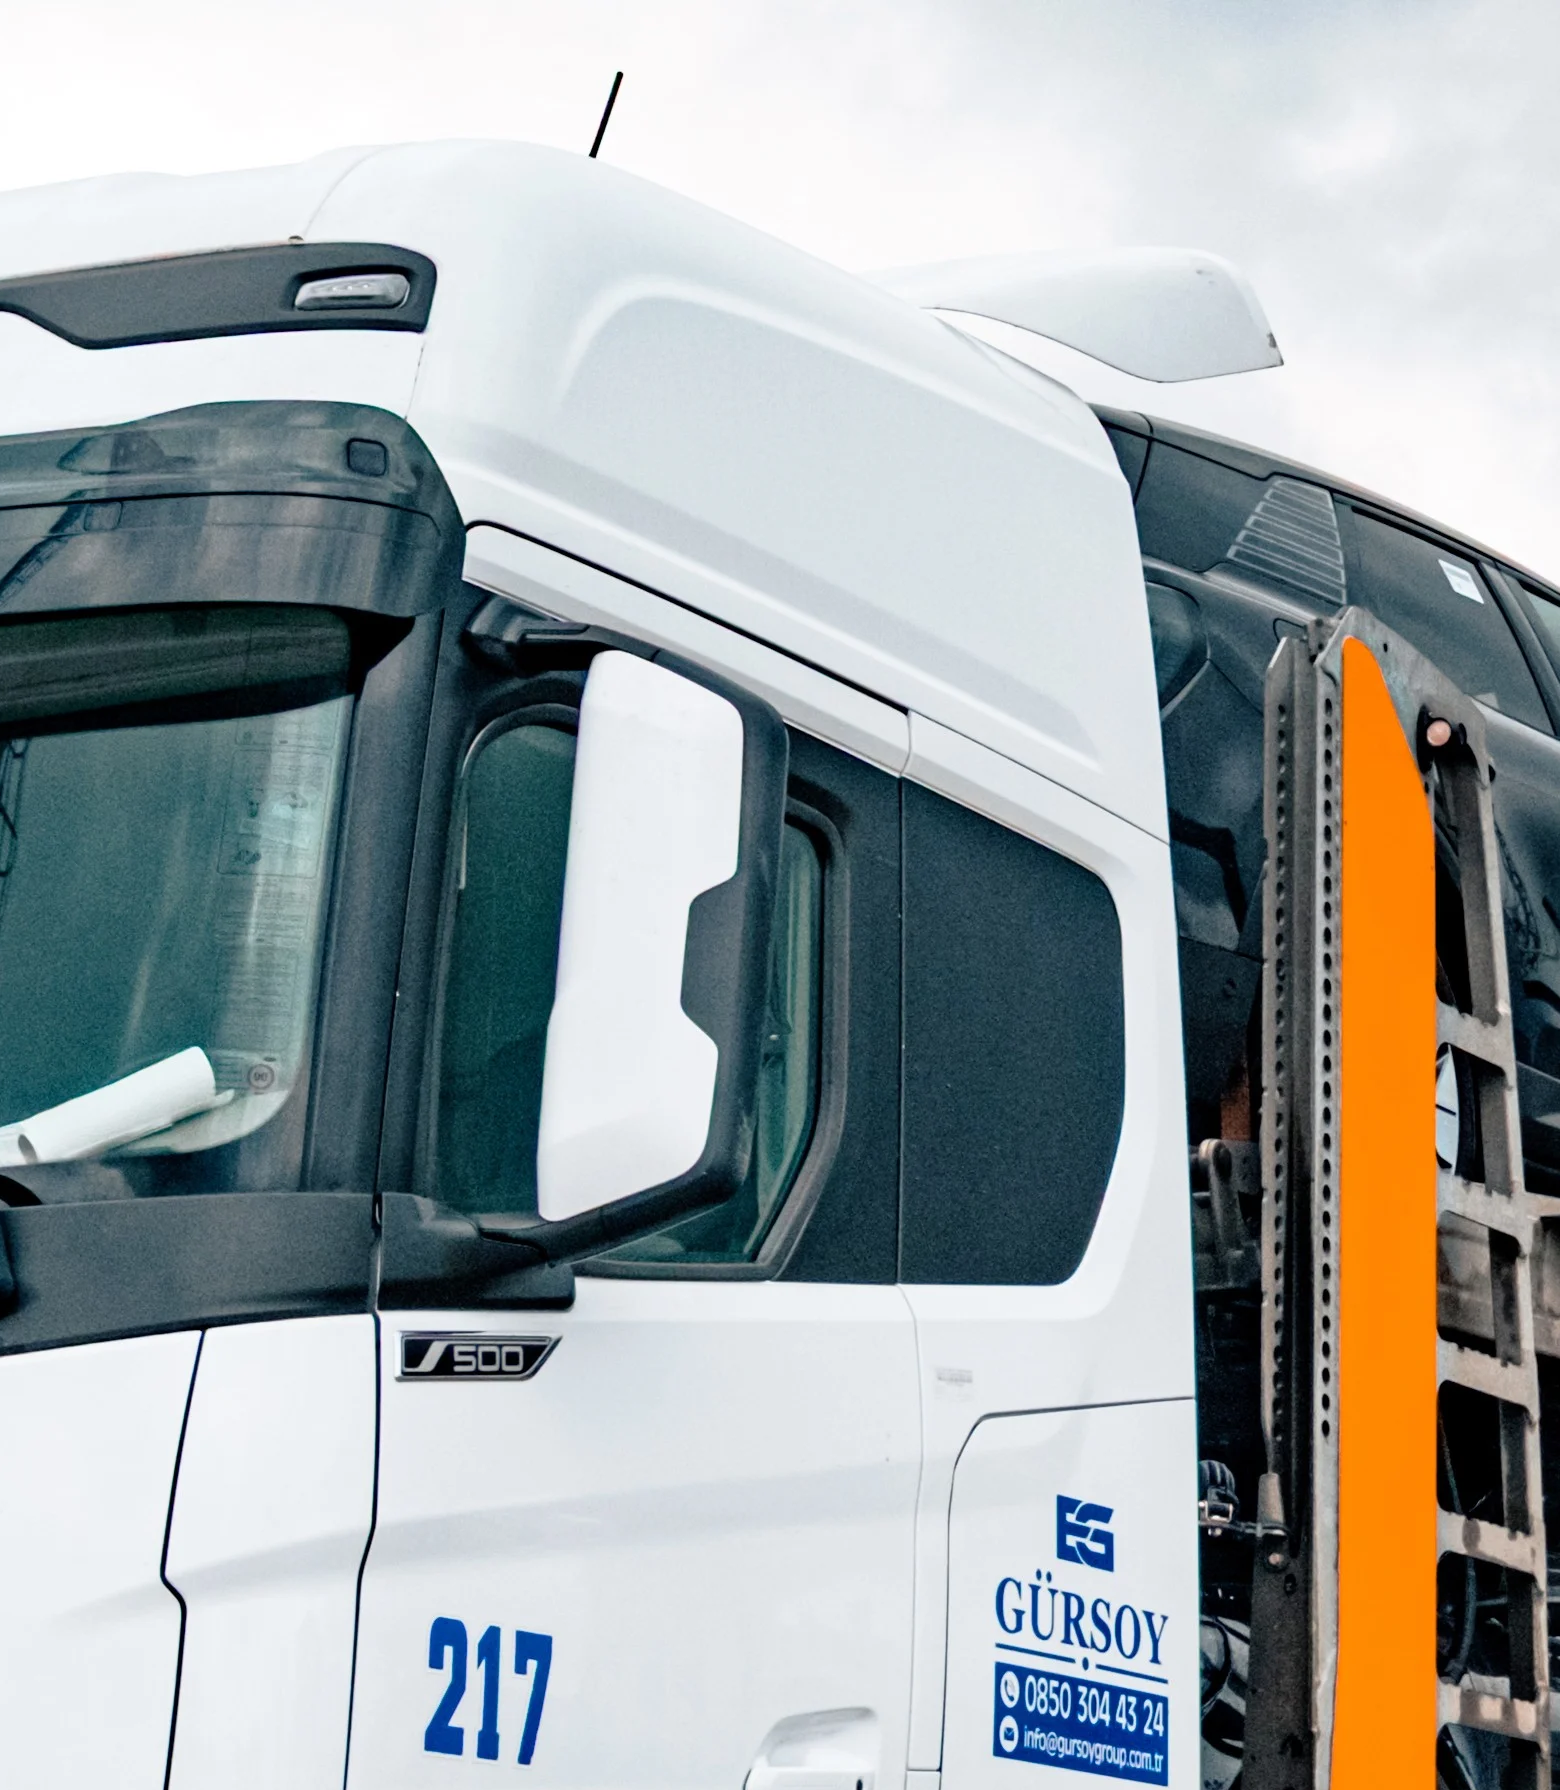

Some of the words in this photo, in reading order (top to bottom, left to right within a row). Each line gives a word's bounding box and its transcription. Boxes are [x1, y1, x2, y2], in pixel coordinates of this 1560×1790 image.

[453, 1344, 524, 1373] 500
[995, 1568, 1169, 1665] GÜRSOY
[424, 1616, 553, 1766] 217
[1025, 1674, 1071, 1719] 0850
[1077, 1685, 1110, 1727] 304
[1116, 1694, 1137, 1732] 43
[1143, 1699, 1164, 1737] 24
[1024, 1725, 1164, 1773] info@gursoygroup.com.tr
